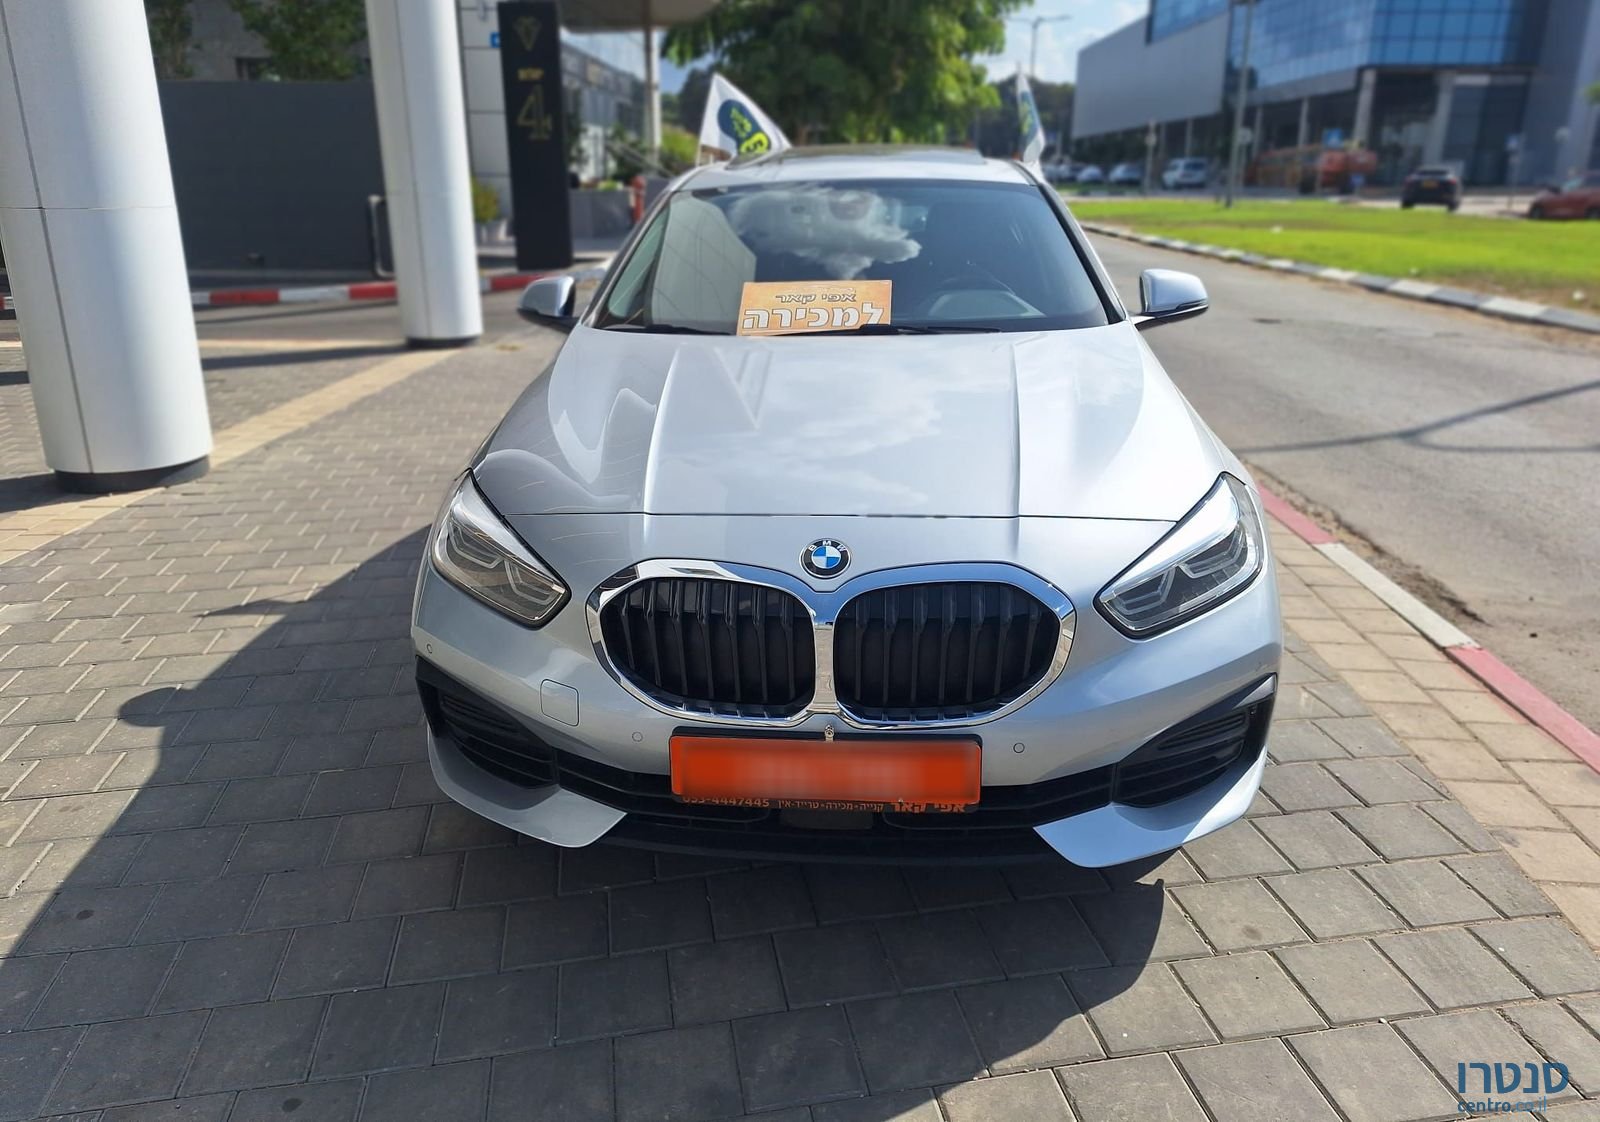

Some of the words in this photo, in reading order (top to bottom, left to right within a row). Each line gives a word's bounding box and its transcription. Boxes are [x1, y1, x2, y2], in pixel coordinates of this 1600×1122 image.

[775, 293, 817, 305] קאר
[821, 293, 857, 303] אפי
[742, 302, 884, 329] למכירה
[808, 540, 848, 552] BMW
